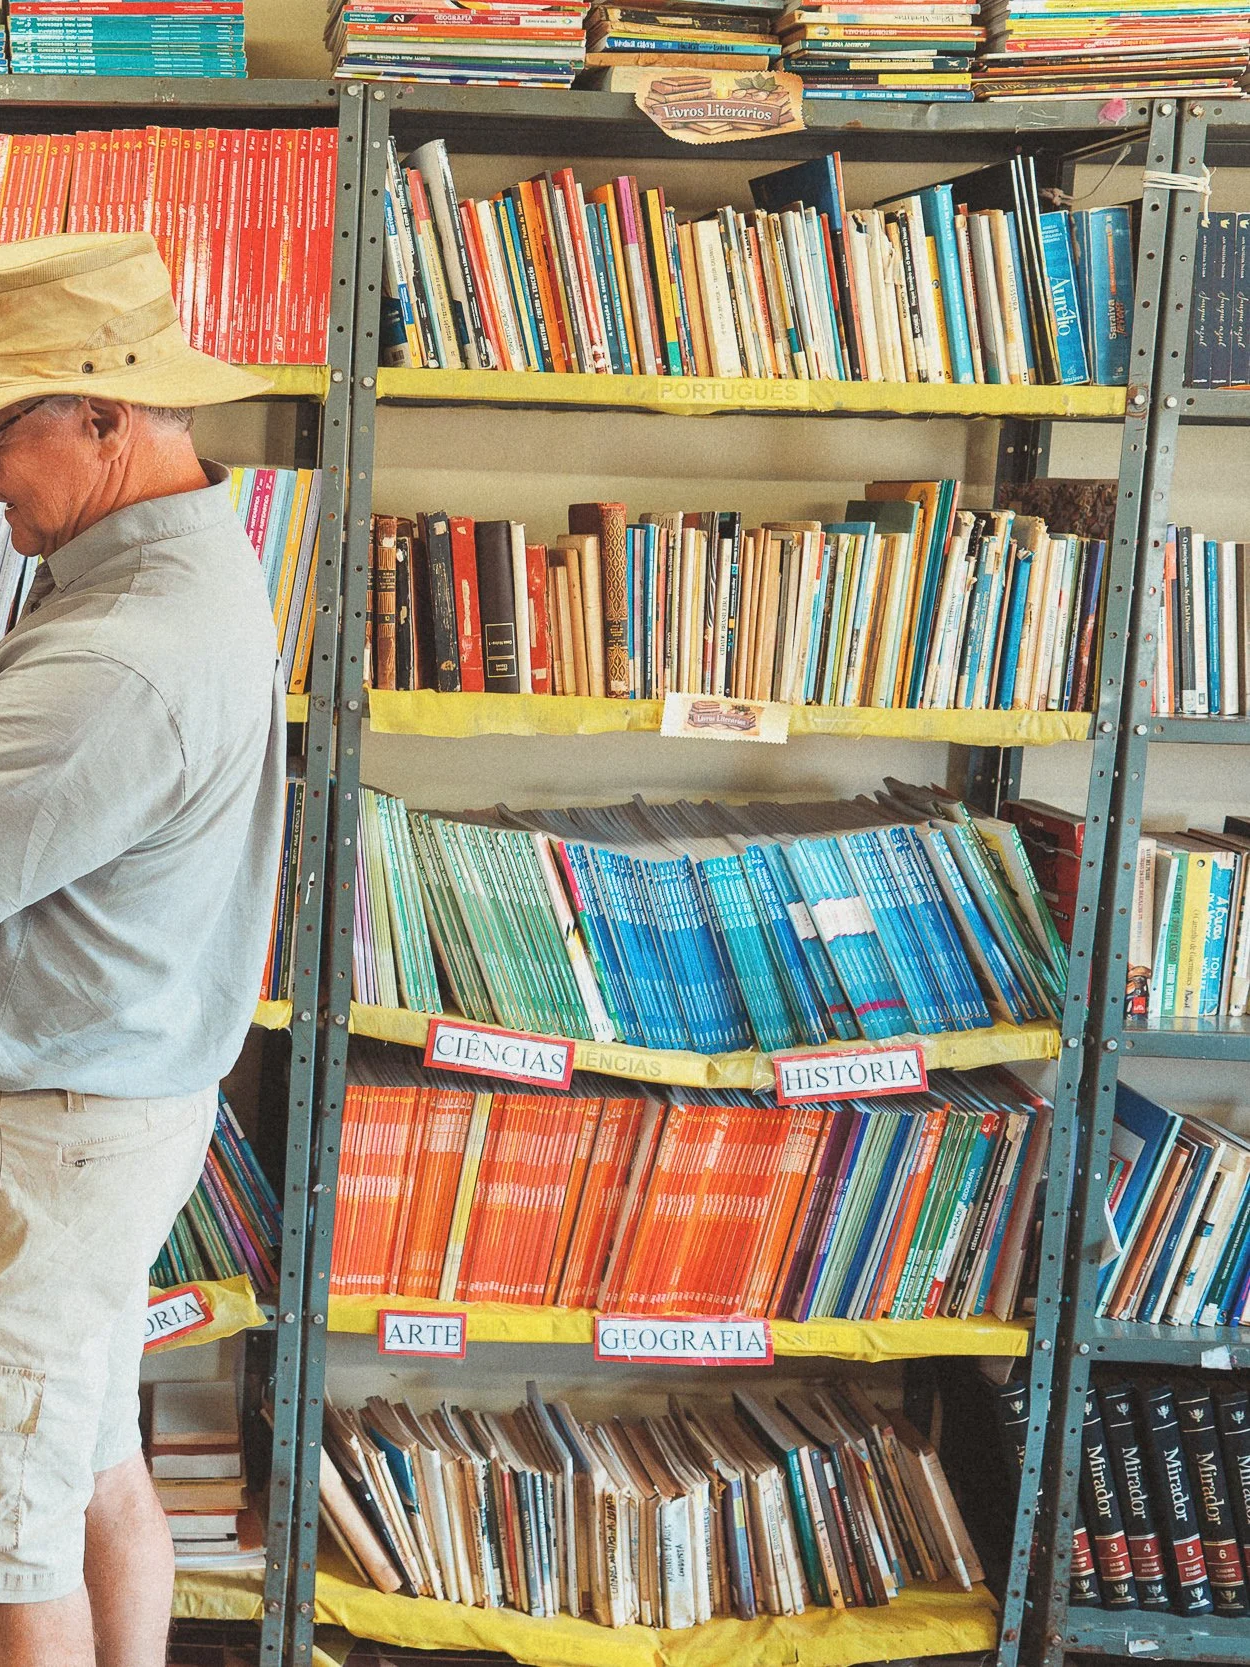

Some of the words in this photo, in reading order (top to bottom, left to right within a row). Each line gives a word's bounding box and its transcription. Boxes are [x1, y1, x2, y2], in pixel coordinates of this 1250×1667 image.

[1083, 39, 1121, 48] CONECTADOS
[662, 105, 704, 119] Livros
[706, 103, 771, 120] Literários
[385, 206, 396, 234] HISTÓRIA
[534, 298, 543, 318] CINEMA
[1049, 276, 1073, 336] Aurélio
[1196, 291, 1210, 322] Sangue
[1217, 291, 1229, 322] Sangue
[1236, 292, 1249, 322] Sangue
[1107, 299, 1116, 339] Saraiva
[1195, 325, 1207, 346] azul
[1215, 325, 1227, 346] azul
[1234, 325, 1246, 347] azul
[659, 373, 798, 406] PORTUGUÊS
[1180, 543, 1188, 565] príncipe
[1182, 589, 1190, 604] Mary
[697, 714, 715, 722] Livros
[716, 715, 746, 725] Literários
[1174, 874, 1184, 891] CHICO
[1172, 892, 1182, 914] MENDES
[1166, 963, 1176, 984] ZUENIR
[1209, 956, 1219, 978] TOM
[1163, 985, 1174, 1010] VENTURA
[435, 1031, 565, 1075] CIÊNCIAS
[574, 1042, 663, 1085] IÊNCIAS
[783, 1055, 920, 1093] HISTÓRIA
[960, 1167, 976, 1201] GEOGRAFIA
[968, 1227, 982, 1250] CIÊNCIAS
[976, 1201, 990, 1227] NATURAIS
[388, 1323, 460, 1348] ARTE
[600, 1326, 765, 1352] GEOGRAFIA
[1087, 1444, 1113, 1519] Mirador
[1122, 1446, 1147, 1519] Mirador
[1164, 1447, 1189, 1522] Mirador
[1196, 1451, 1226, 1526] Mirador
[1073, 1539, 1080, 1549] 2
[1110, 1542, 1119, 1553] 3
[1143, 1542, 1151, 1553] 4
[1186, 1545, 1194, 1556] 5
[1218, 1549, 1227, 1559] 6
